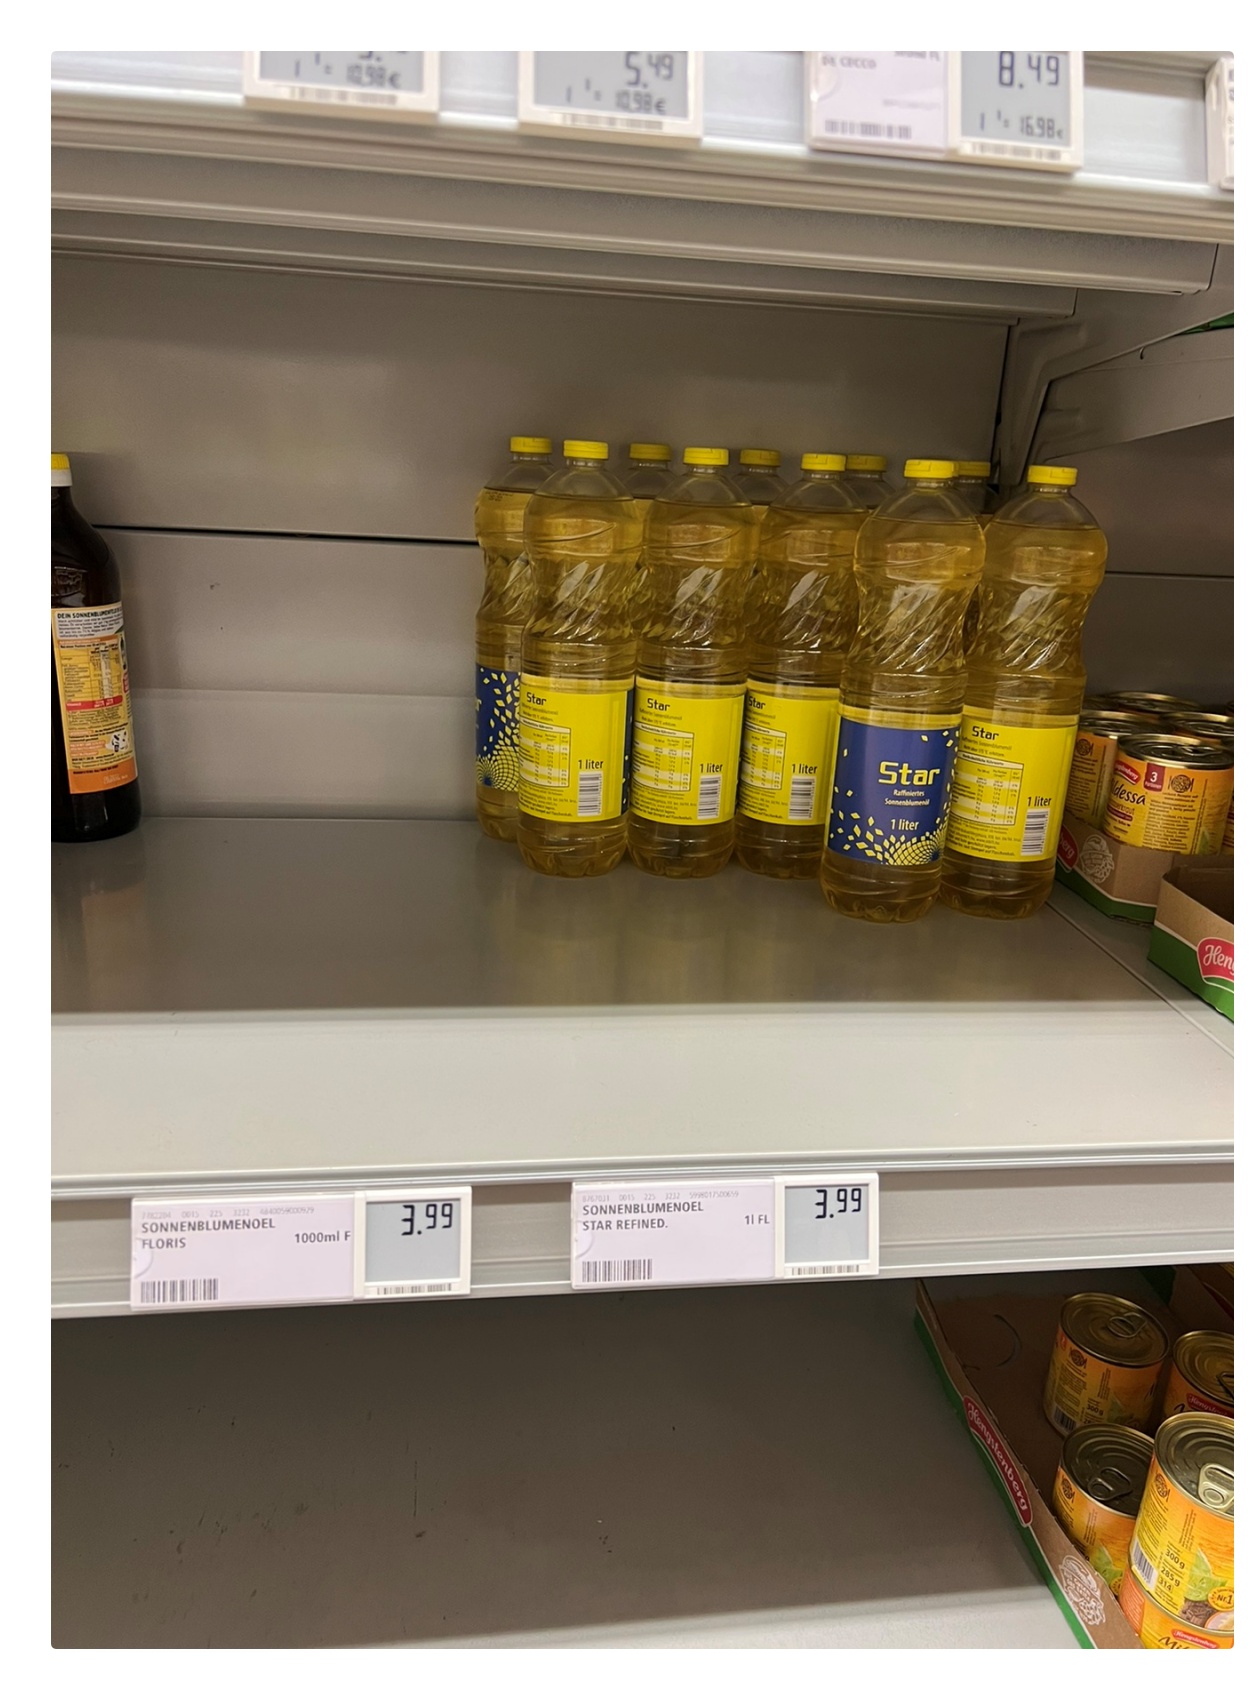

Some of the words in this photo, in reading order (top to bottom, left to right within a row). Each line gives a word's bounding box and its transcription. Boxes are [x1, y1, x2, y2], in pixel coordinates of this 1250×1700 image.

[999, 51, 1060, 89] 8.49
[526, 691, 547, 706] Star
[647, 697, 671, 711] Star
[748, 696, 766, 710] Star
[972, 726, 999, 740] Star
[578, 759, 582, 769] 1
[584, 758, 604, 770] liter
[705, 762, 723, 773] liter
[798, 762, 818, 774] liter
[878, 761, 941, 786] Star
[1150, 771, 1158, 783] 3
[893, 789, 925, 798] Raffiniertes
[884, 797, 930, 807] Sonnenblumenöl
[1034, 796, 1052, 807] liter
[891, 819, 896, 830] 1
[898, 818, 919, 831] liter
[582, 1202, 704, 1216] SONNENBLUMENOEL
[815, 1188, 862, 1219] 3.99
[141, 1218, 276, 1233] SONNENBLUMENOEL
[401, 1203, 453, 1236] 3.99
[582, 1220, 612, 1231] STAR
[616, 1218, 668, 1230] REFINED.
[758, 1214, 770, 1225] FL
[141, 1237, 186, 1250] FLORIS
[294, 1231, 339, 1244] 1000ml
[345, 1231, 351, 1241] F
[967, 1402, 1028, 1511] Hengstenberg
